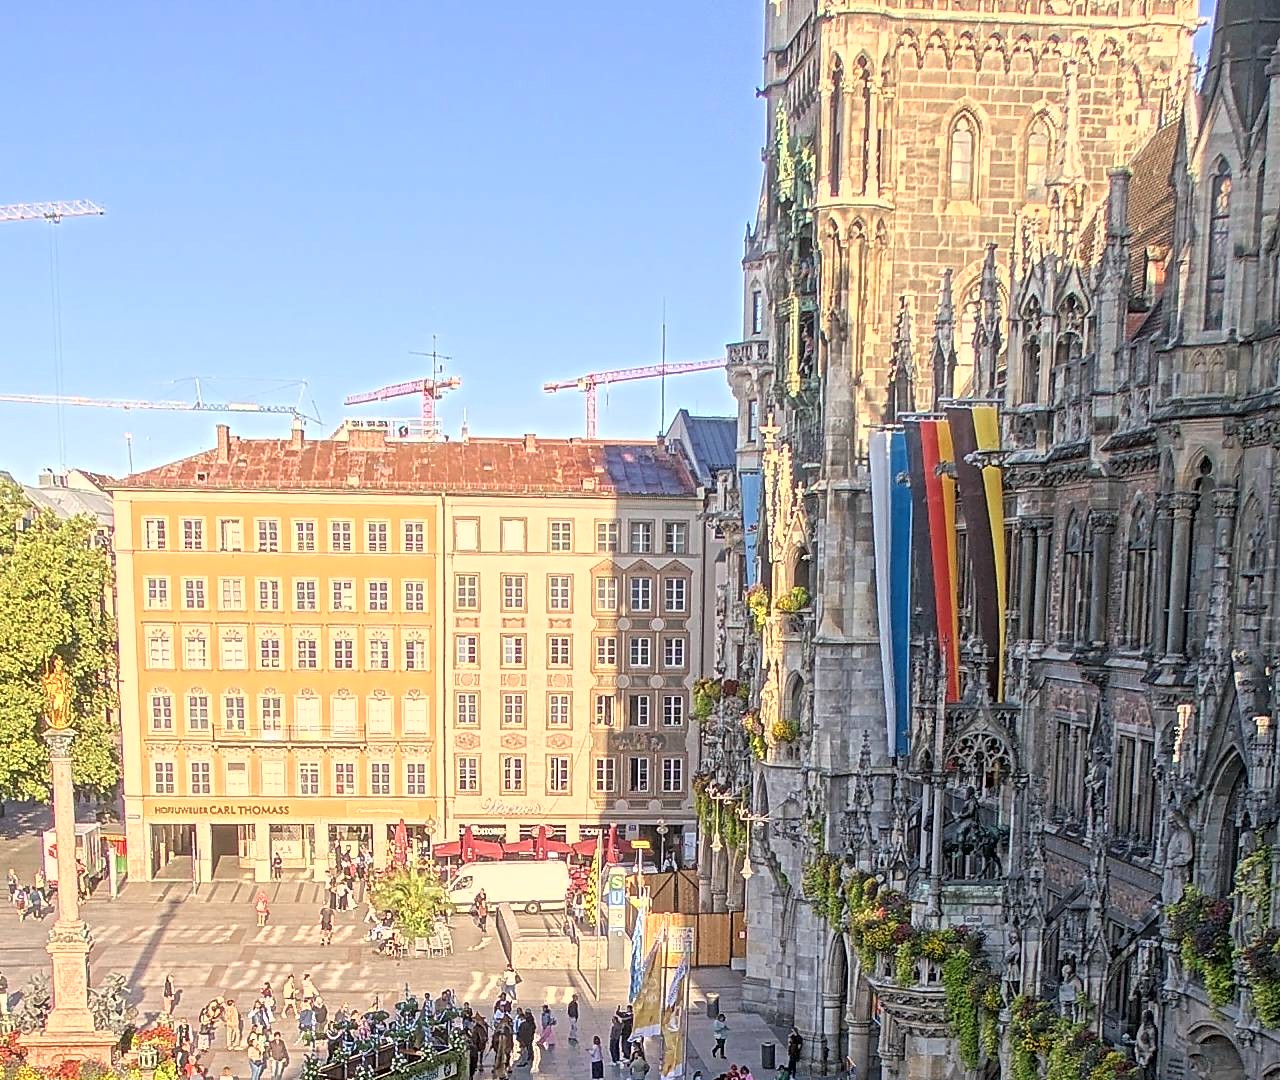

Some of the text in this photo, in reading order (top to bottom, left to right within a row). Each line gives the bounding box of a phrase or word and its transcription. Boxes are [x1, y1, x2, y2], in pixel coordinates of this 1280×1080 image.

[210, 805, 237, 815] CARL
[237, 805, 290, 815] THOMASS
[611, 875, 623, 889] S
[611, 891, 622, 905] U
